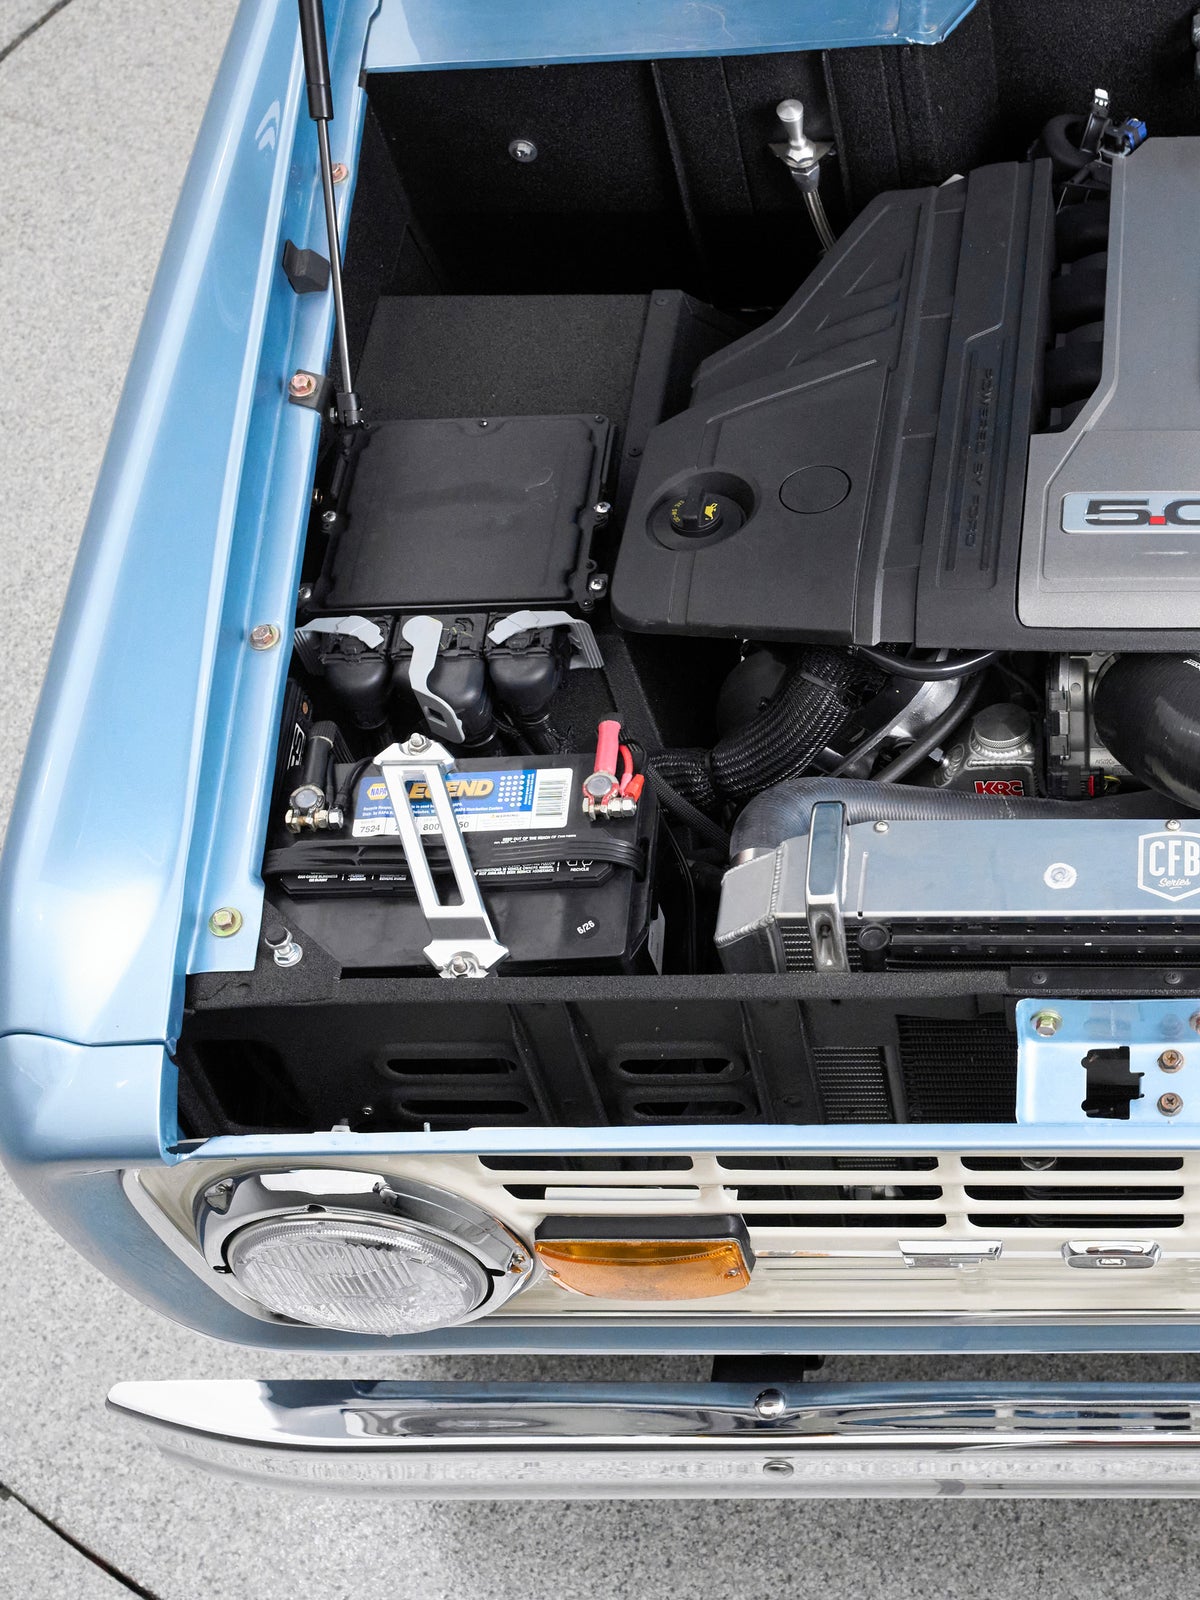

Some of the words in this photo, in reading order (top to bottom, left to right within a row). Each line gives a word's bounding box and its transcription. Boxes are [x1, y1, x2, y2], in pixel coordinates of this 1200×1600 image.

[408, 779, 494, 800] EEND
[974, 781, 1025, 797] KRC
[360, 824, 381, 833] 7524
[1149, 840, 1200, 877] CFB
[1158, 877, 1191, 889] Series
[576, 919, 596, 935] 6/26
